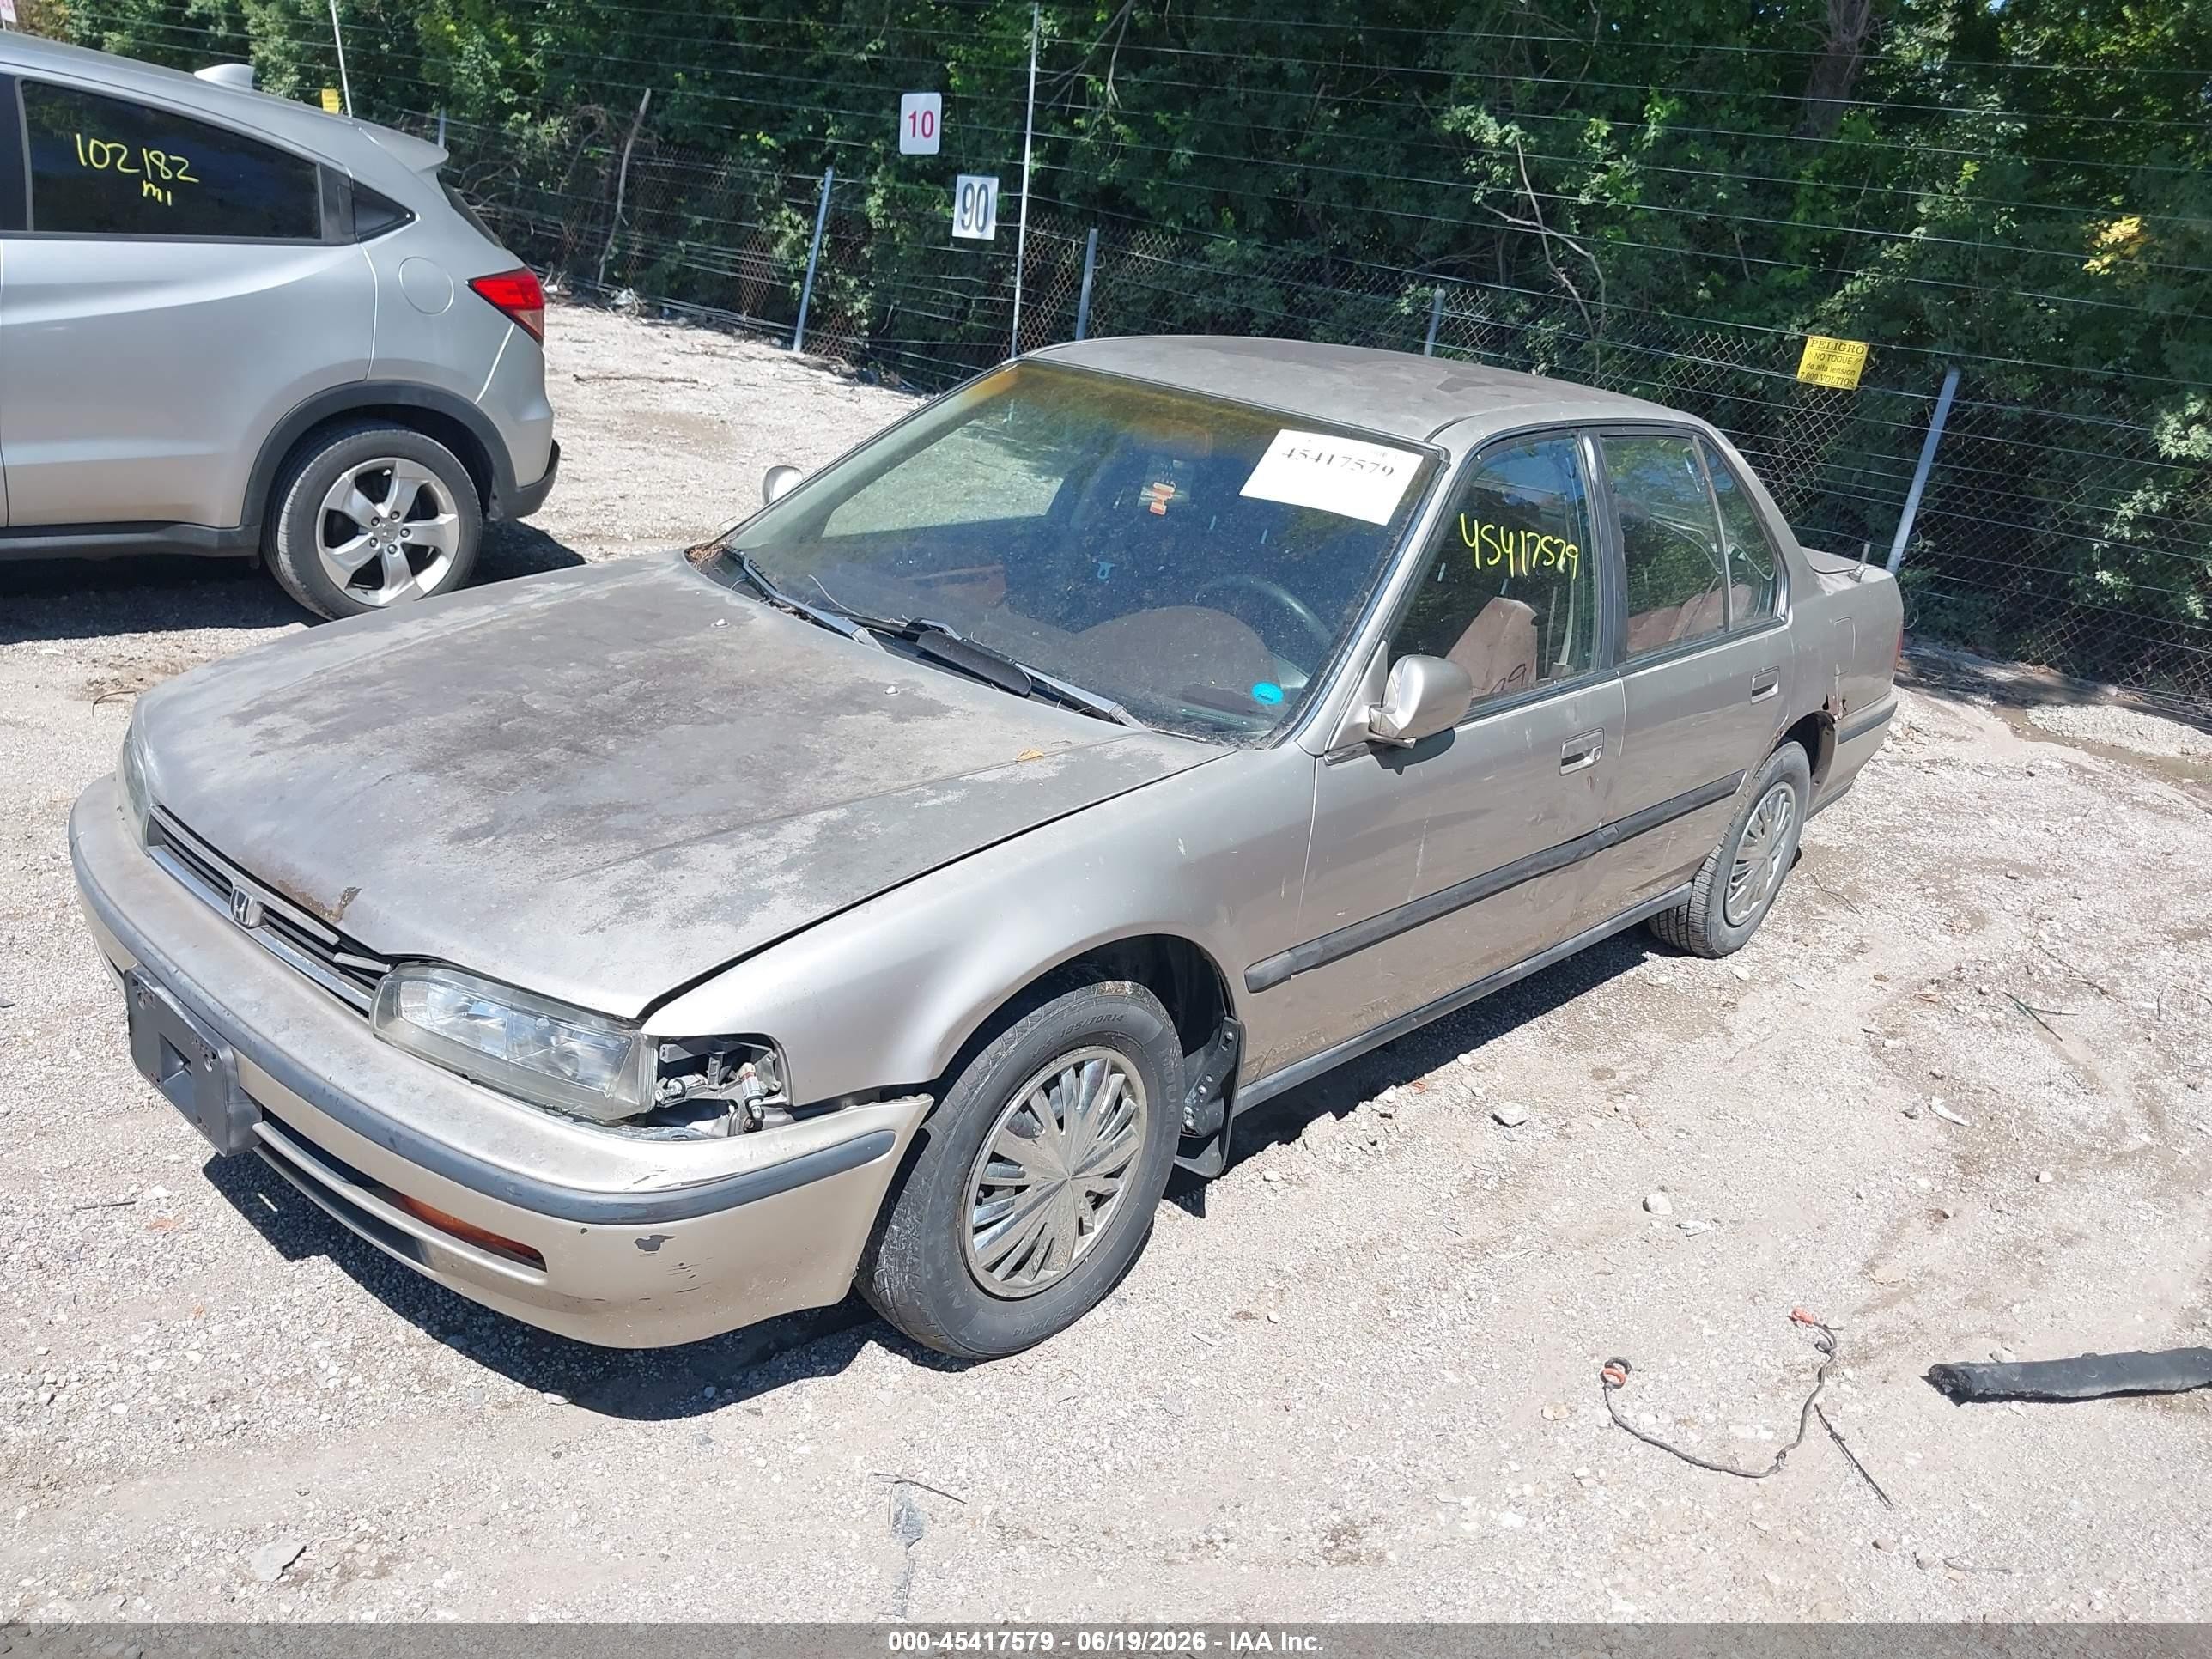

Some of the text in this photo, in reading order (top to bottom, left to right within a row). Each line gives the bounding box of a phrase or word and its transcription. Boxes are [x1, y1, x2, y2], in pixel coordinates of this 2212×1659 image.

[908, 110, 934, 138] 10
[76, 133, 199, 183] 102182
[961, 182, 989, 233] 90
[1809, 339, 1864, 355] PELIGRO
[1814, 352, 1853, 365] NO TOQUE
[1806, 362, 1814, 370] de
[1815, 363, 1829, 372] alta
[1820, 374, 1855, 386] VOLTIOS
[1282, 447, 1394, 476] 45417579
[1461, 513, 1578, 580] 45417579
